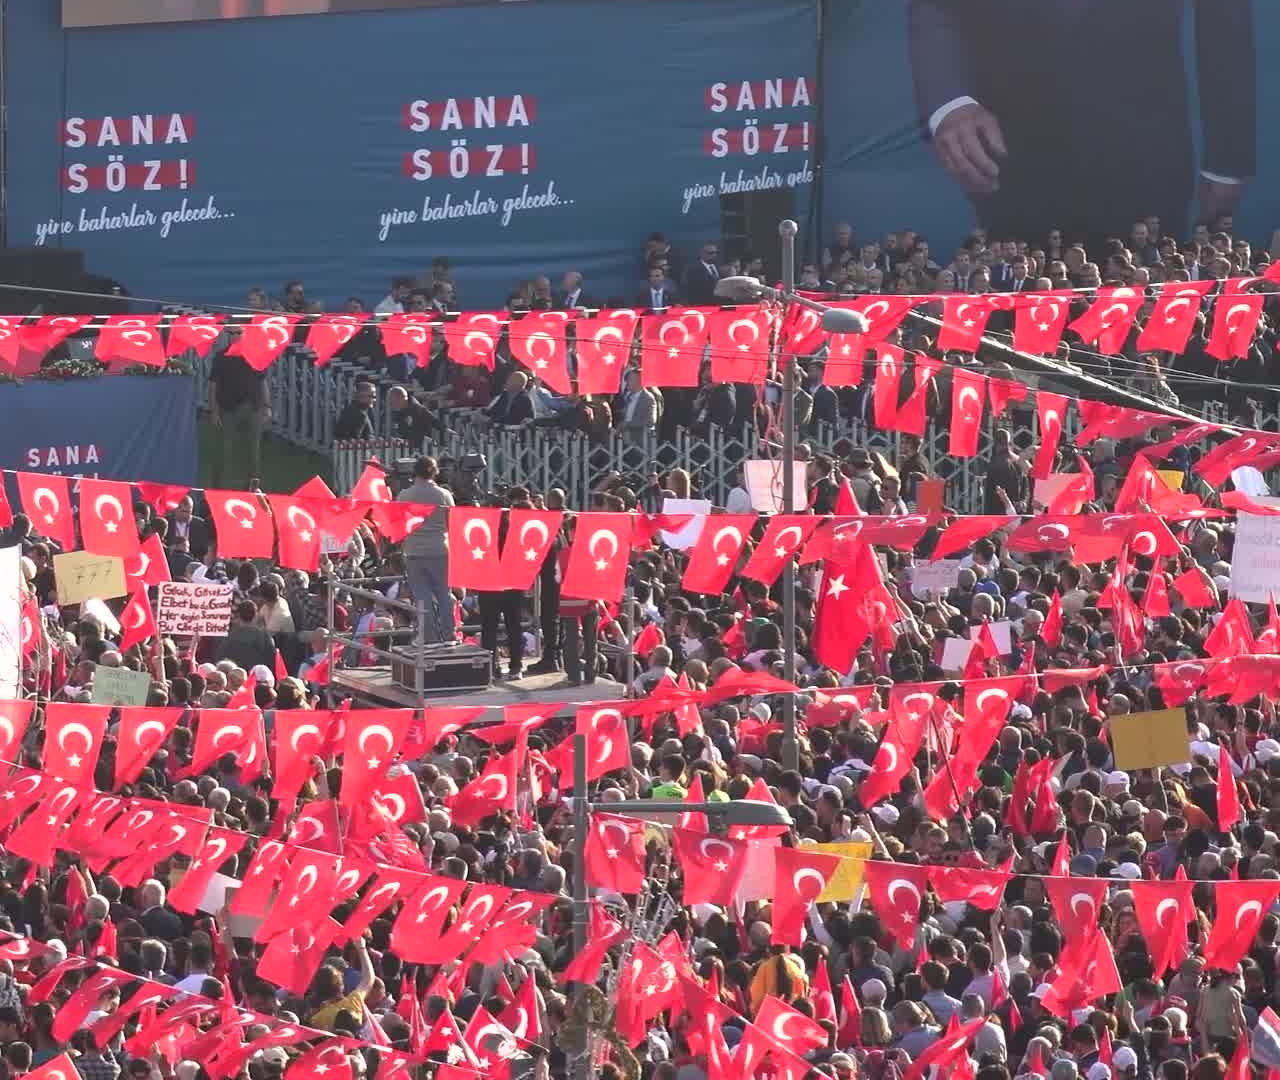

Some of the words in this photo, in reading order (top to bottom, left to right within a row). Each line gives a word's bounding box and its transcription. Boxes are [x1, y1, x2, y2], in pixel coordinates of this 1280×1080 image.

[410, 94, 529, 132] SANA
[711, 77, 811, 113] SANA
[66, 113, 188, 148] SANA
[712, 118, 809, 157] SÖZ!
[68, 154, 188, 193] SÖZ!
[412, 139, 529, 181] SÖZ!
[683, 183, 715, 213] yine
[718, 165, 783, 194] baharlar
[34, 219, 74, 250] yine
[78, 203, 156, 231] baharlar
[379, 208, 418, 241] yine
[422, 190, 498, 221] baharlar
[28, 444, 99, 467] SANA
